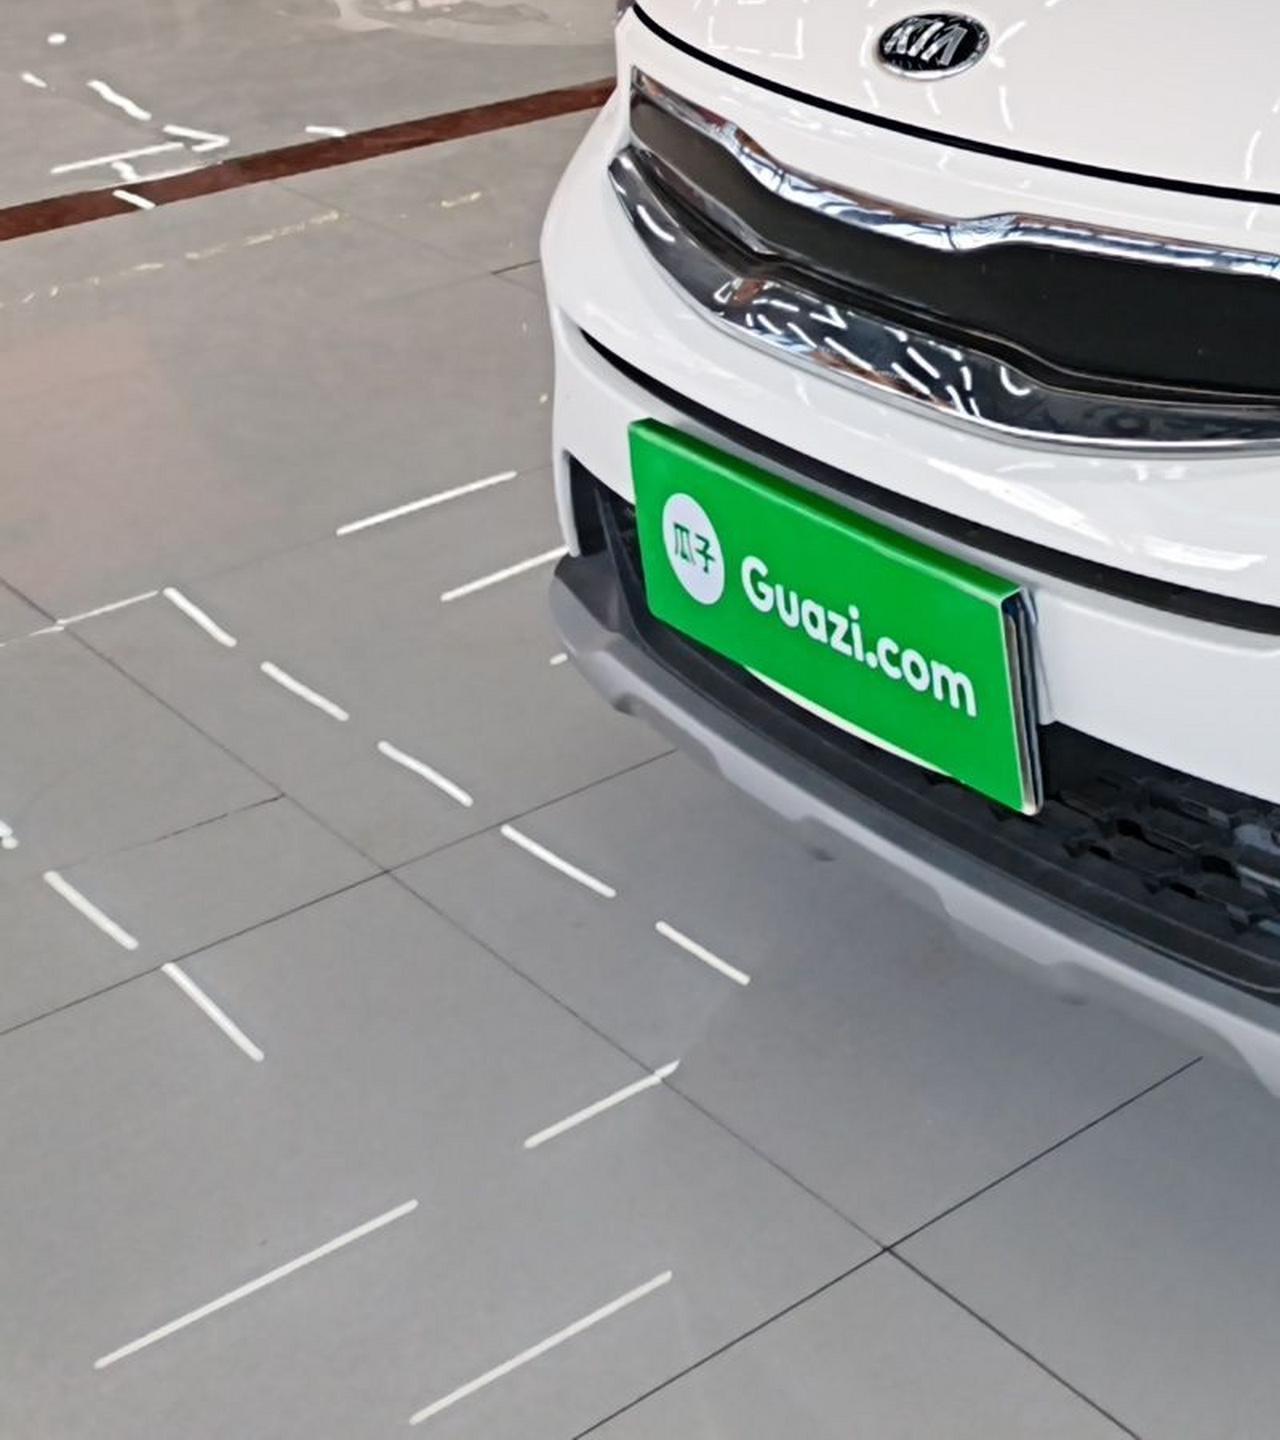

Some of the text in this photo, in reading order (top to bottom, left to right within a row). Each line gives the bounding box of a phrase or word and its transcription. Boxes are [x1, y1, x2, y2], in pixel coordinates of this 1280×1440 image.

[883, 20, 968, 66] KIA
[673, 522, 716, 574] 瓜子
[740, 555, 977, 718] Guazi.com
